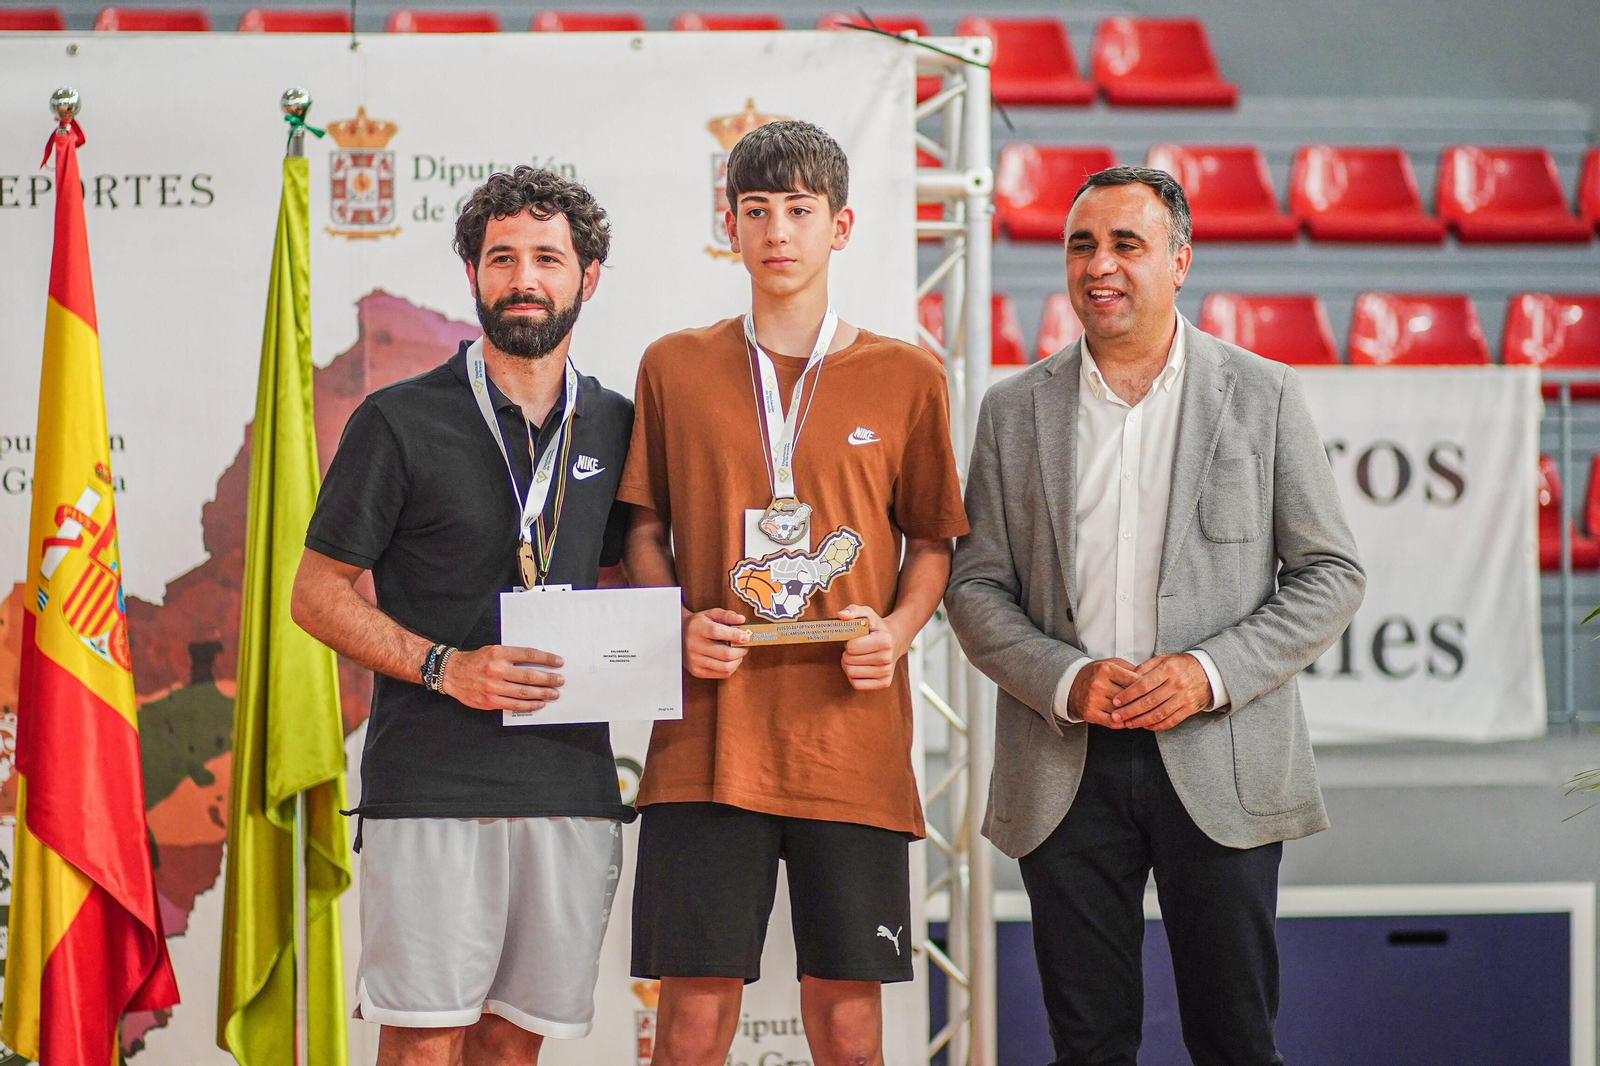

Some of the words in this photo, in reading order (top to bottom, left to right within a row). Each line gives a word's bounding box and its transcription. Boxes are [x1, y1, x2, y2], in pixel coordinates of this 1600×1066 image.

[413, 155, 576, 187] Diputain
[0, 173, 215, 210] EPRTES
[412, 195, 444, 222] de
[854, 426, 875, 440] NIKE
[577, 454, 599, 472] NIKE
